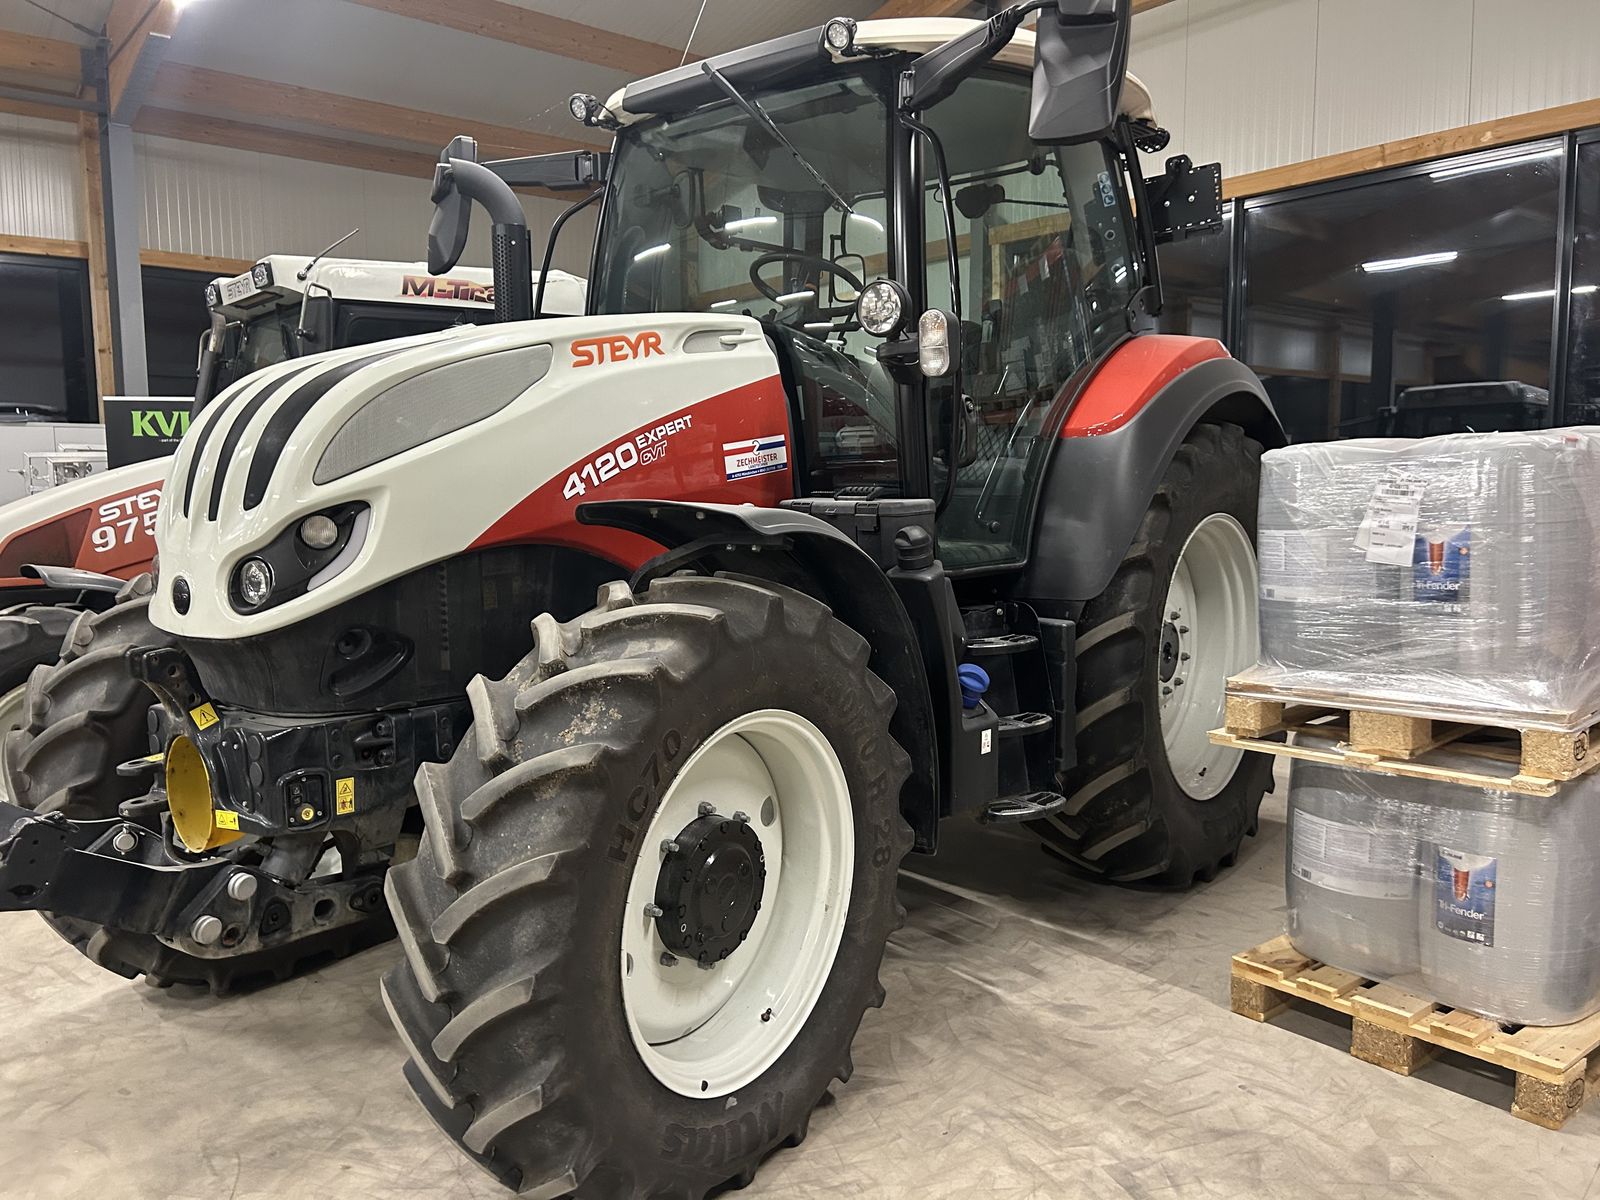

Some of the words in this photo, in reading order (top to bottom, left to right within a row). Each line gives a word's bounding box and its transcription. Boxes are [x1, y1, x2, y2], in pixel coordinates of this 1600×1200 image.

[226, 277, 252, 300] STEYR
[571, 331, 665, 368] STEYR
[636, 414, 693, 450] EXPERT
[562, 439, 638, 501] 4120
[639, 440, 668, 466] CVT
[736, 453, 778, 467] ZECHMEISTER
[91, 511, 157, 553] 975
[607, 727, 682, 863] HC70
